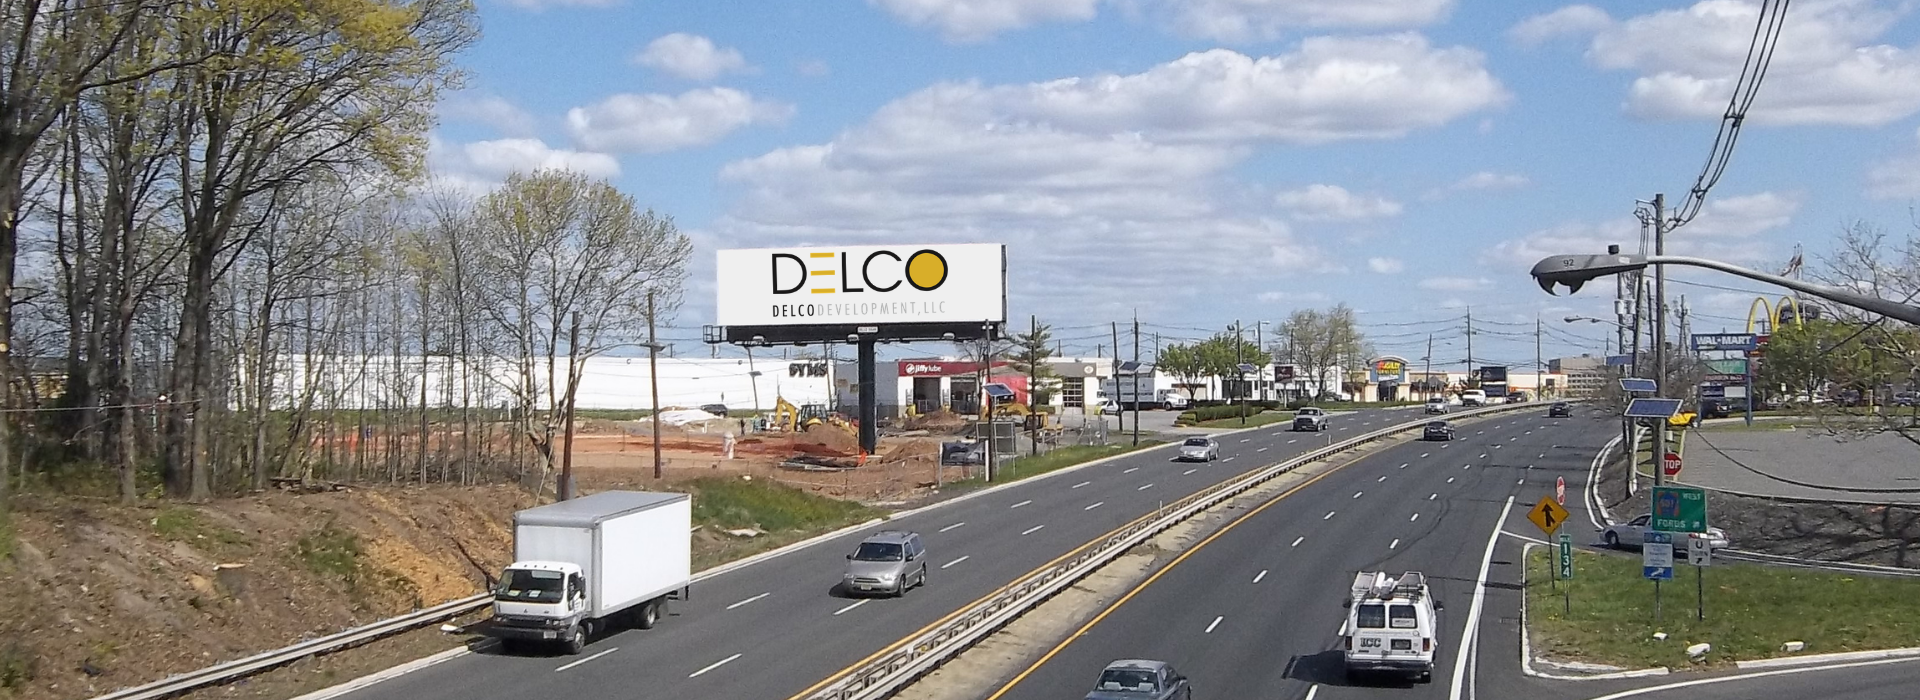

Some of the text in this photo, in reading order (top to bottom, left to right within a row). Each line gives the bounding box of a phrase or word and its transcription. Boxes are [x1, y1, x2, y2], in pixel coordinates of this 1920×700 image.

[1563, 258, 1574, 267] 92
[772, 249, 948, 294] DELCO
[1664, 459, 1681, 469] TOP
[1682, 492, 1701, 501] WEST
[1657, 518, 1686, 528] FORDS
[1695, 540, 1704, 549] U
